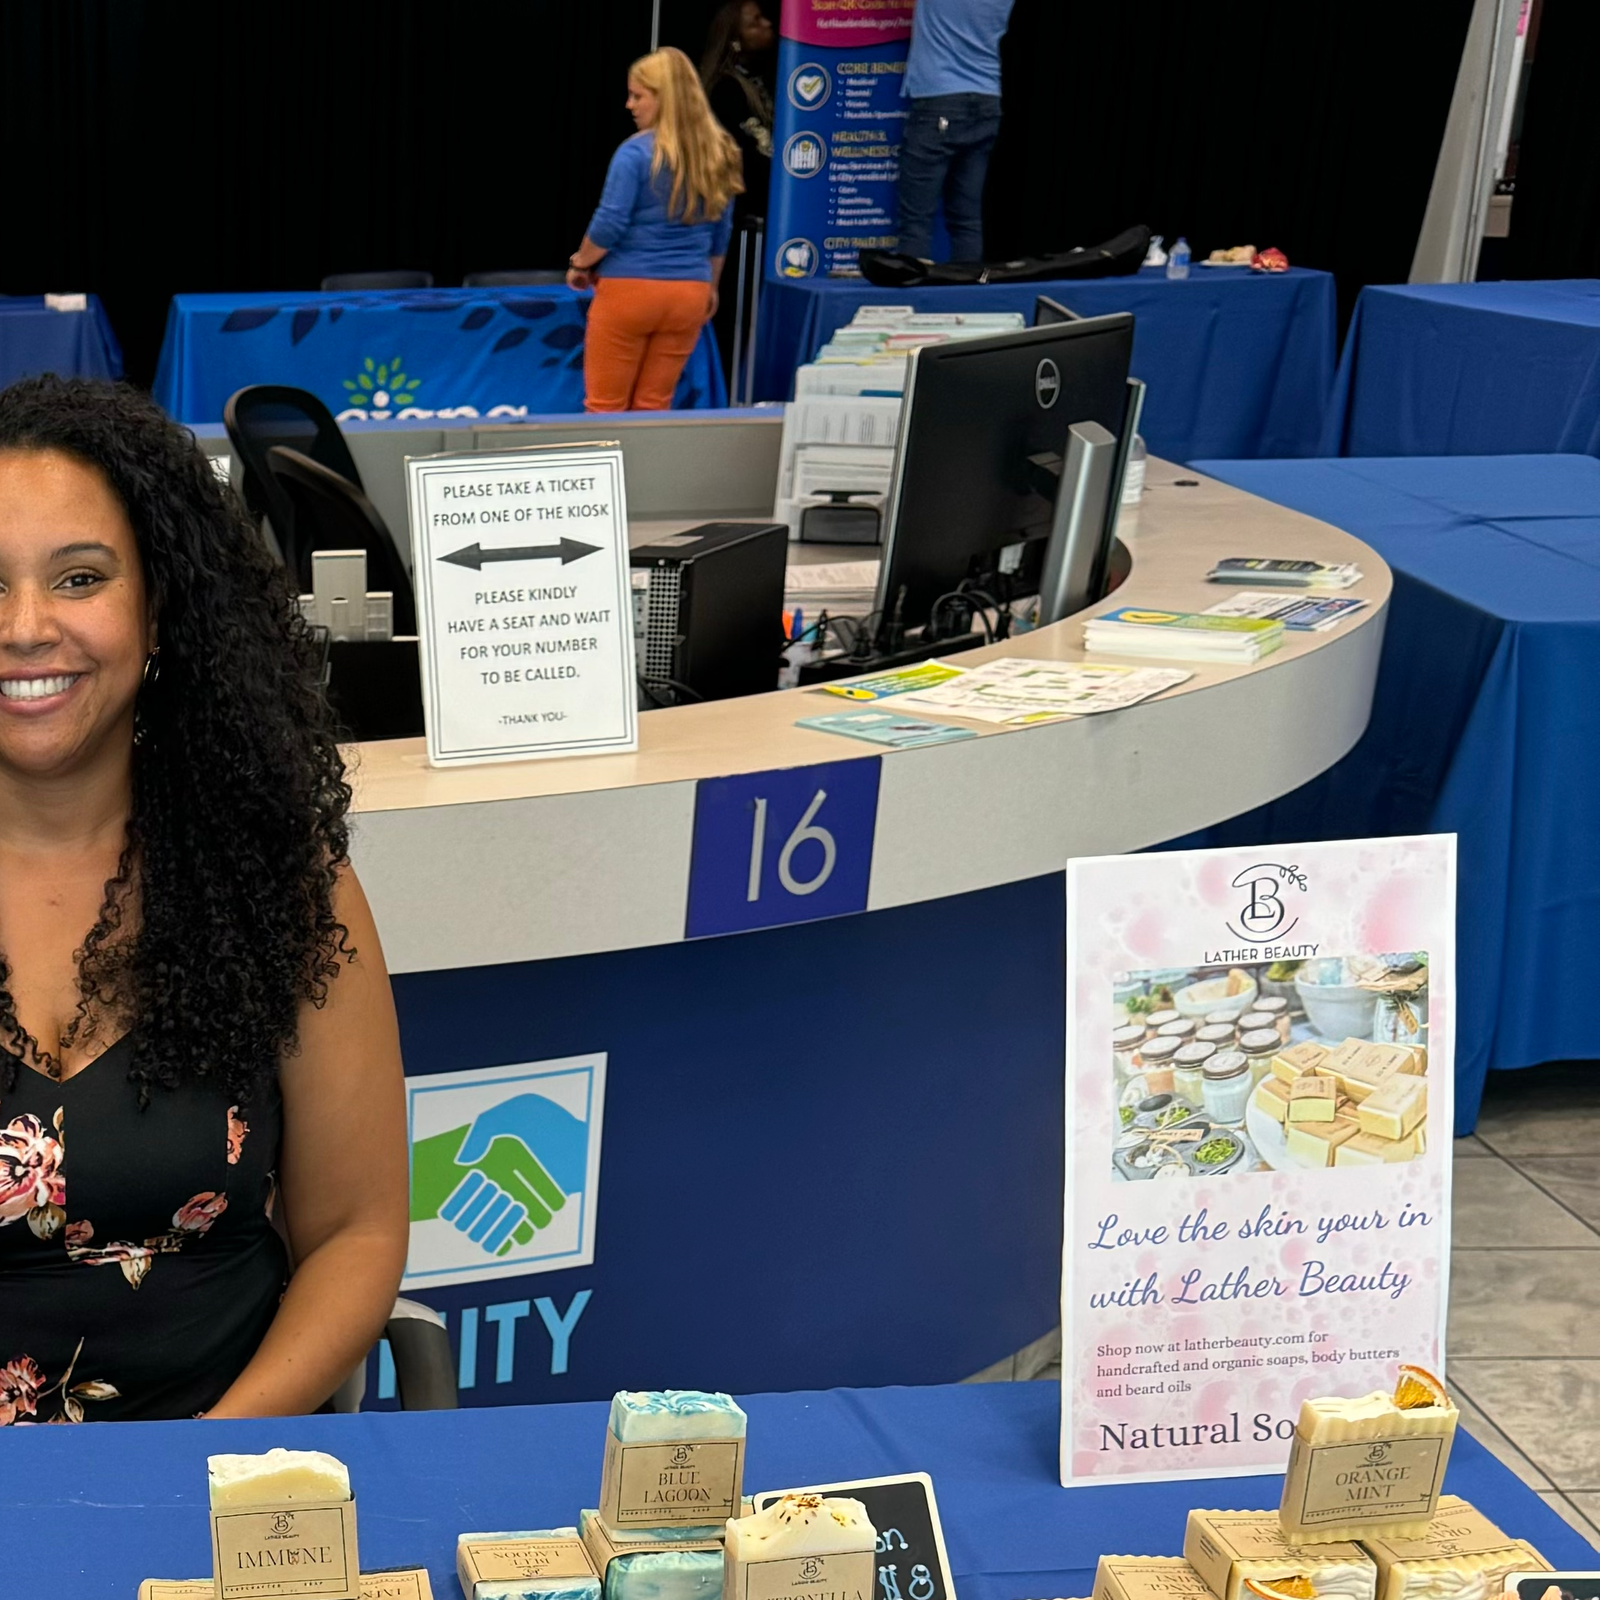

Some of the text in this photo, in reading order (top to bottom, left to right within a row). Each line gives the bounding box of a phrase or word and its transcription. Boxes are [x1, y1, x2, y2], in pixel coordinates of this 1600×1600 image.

[443, 477, 596, 499] PLEASE TAKE A TICKET
[433, 503, 609, 527] FROM ONE OF THE KIOSK
[475, 586, 578, 605] PLEASE KINDLY
[448, 610, 611, 634] HAVE A SEAT AND WAIT
[460, 637, 598, 660] FOR YOUR NUMBER
[481, 665, 581, 684] TO BE CALLED.
[747, 788, 837, 902] 16
[1204, 943, 1320, 964] LATHER BEAUTY
[1087, 1202, 1433, 1250] Love the skin your in
[1090, 1260, 1413, 1310] with Lather Beauty
[1096, 1330, 1329, 1359] Shop now at latherbeauty.com for
[1096, 1346, 1401, 1378] handcrafted and organic soaps, body butters
[1096, 1379, 1192, 1398] and beard oils
[1100, 1412, 1240, 1452] Natural
[659, 1471, 700, 1486] BLUE
[1336, 1466, 1411, 1486] ORANGE
[644, 1488, 711, 1504] LAGOON
[1345, 1484, 1396, 1501] MINT
[237, 1546, 333, 1569] IMMUNE
